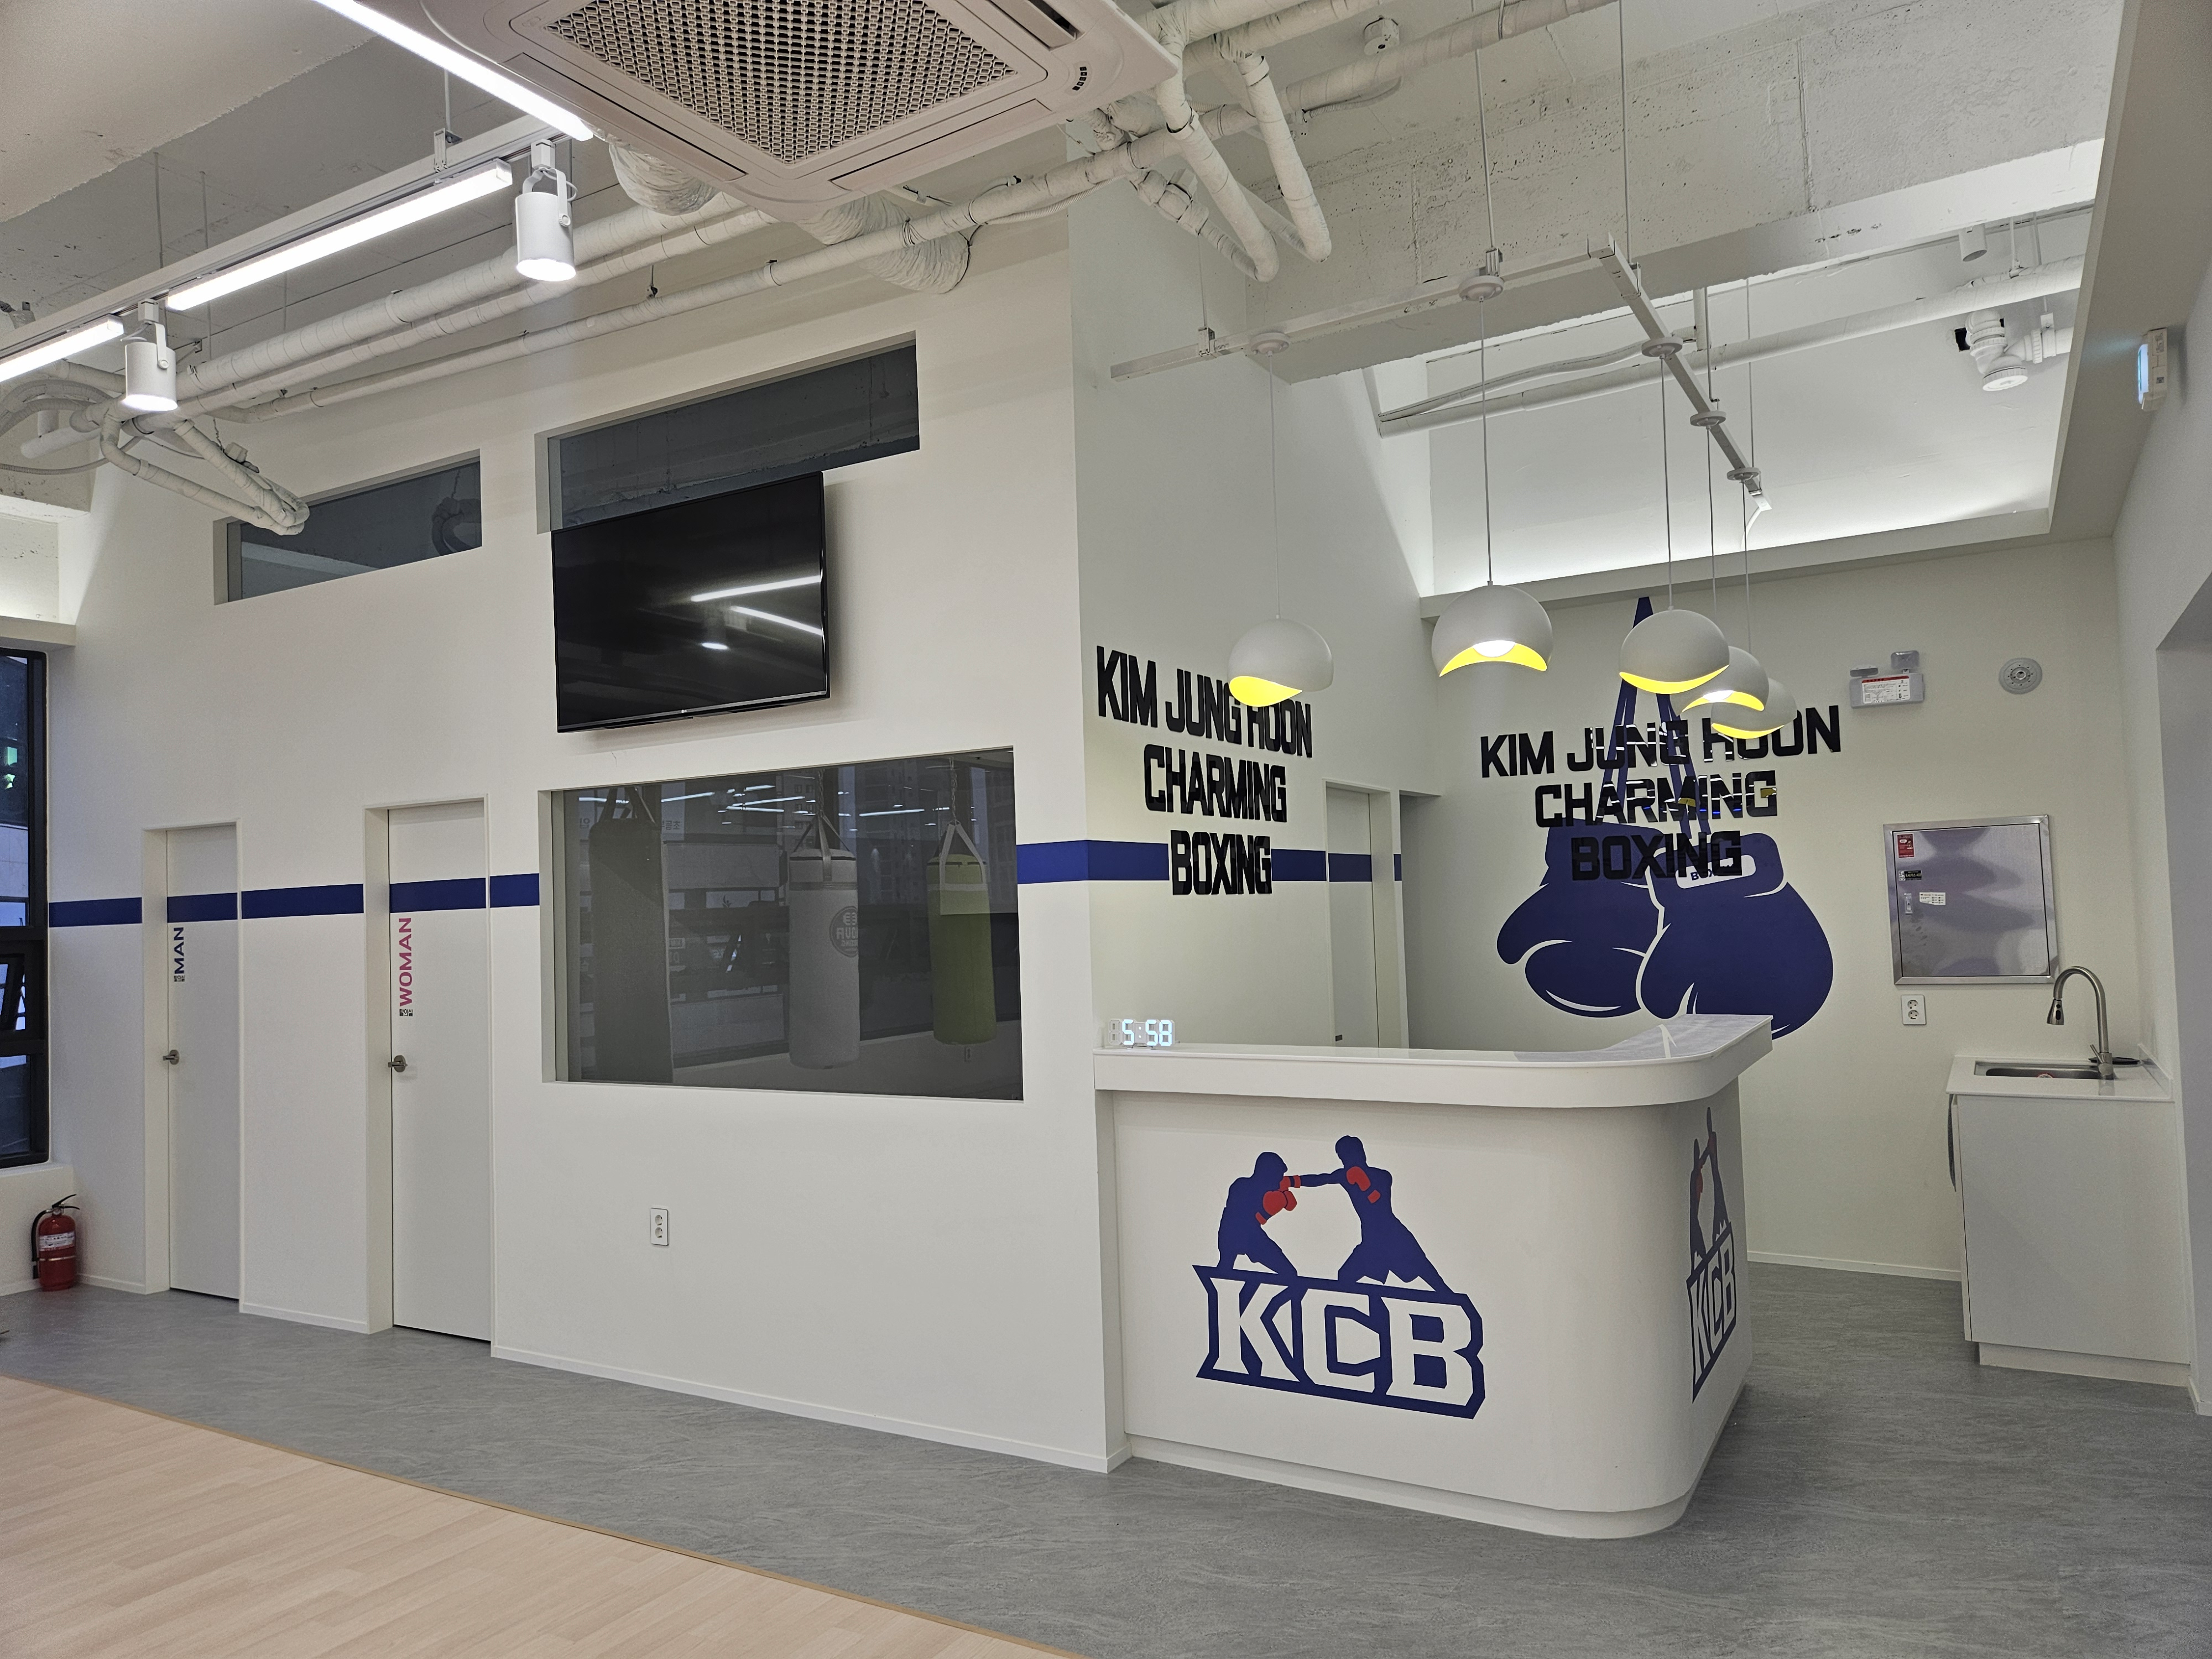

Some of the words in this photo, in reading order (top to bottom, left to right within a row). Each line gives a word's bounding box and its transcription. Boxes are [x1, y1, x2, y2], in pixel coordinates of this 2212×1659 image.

[1097, 645, 1158, 728] KIM
[1165, 669, 1242, 744] JUNG
[1247, 698, 1312, 758] HOON
[1480, 731, 1554, 778] KIM
[1567, 720, 1689, 772] JUNG
[1144, 744, 1287, 822] CHARMING
[1535, 770, 1778, 828] CHARMING
[1171, 830, 1272, 895] BOXING
[1571, 831, 1743, 881] BOXING
[174, 927, 185, 974] MAN
[399, 918, 413, 1007] WOMAN
[1122, 1019, 1172, 1046] 5:58
[1197, 1269, 1483, 1416] KCB
[1688, 1225, 1736, 1396] KCB
